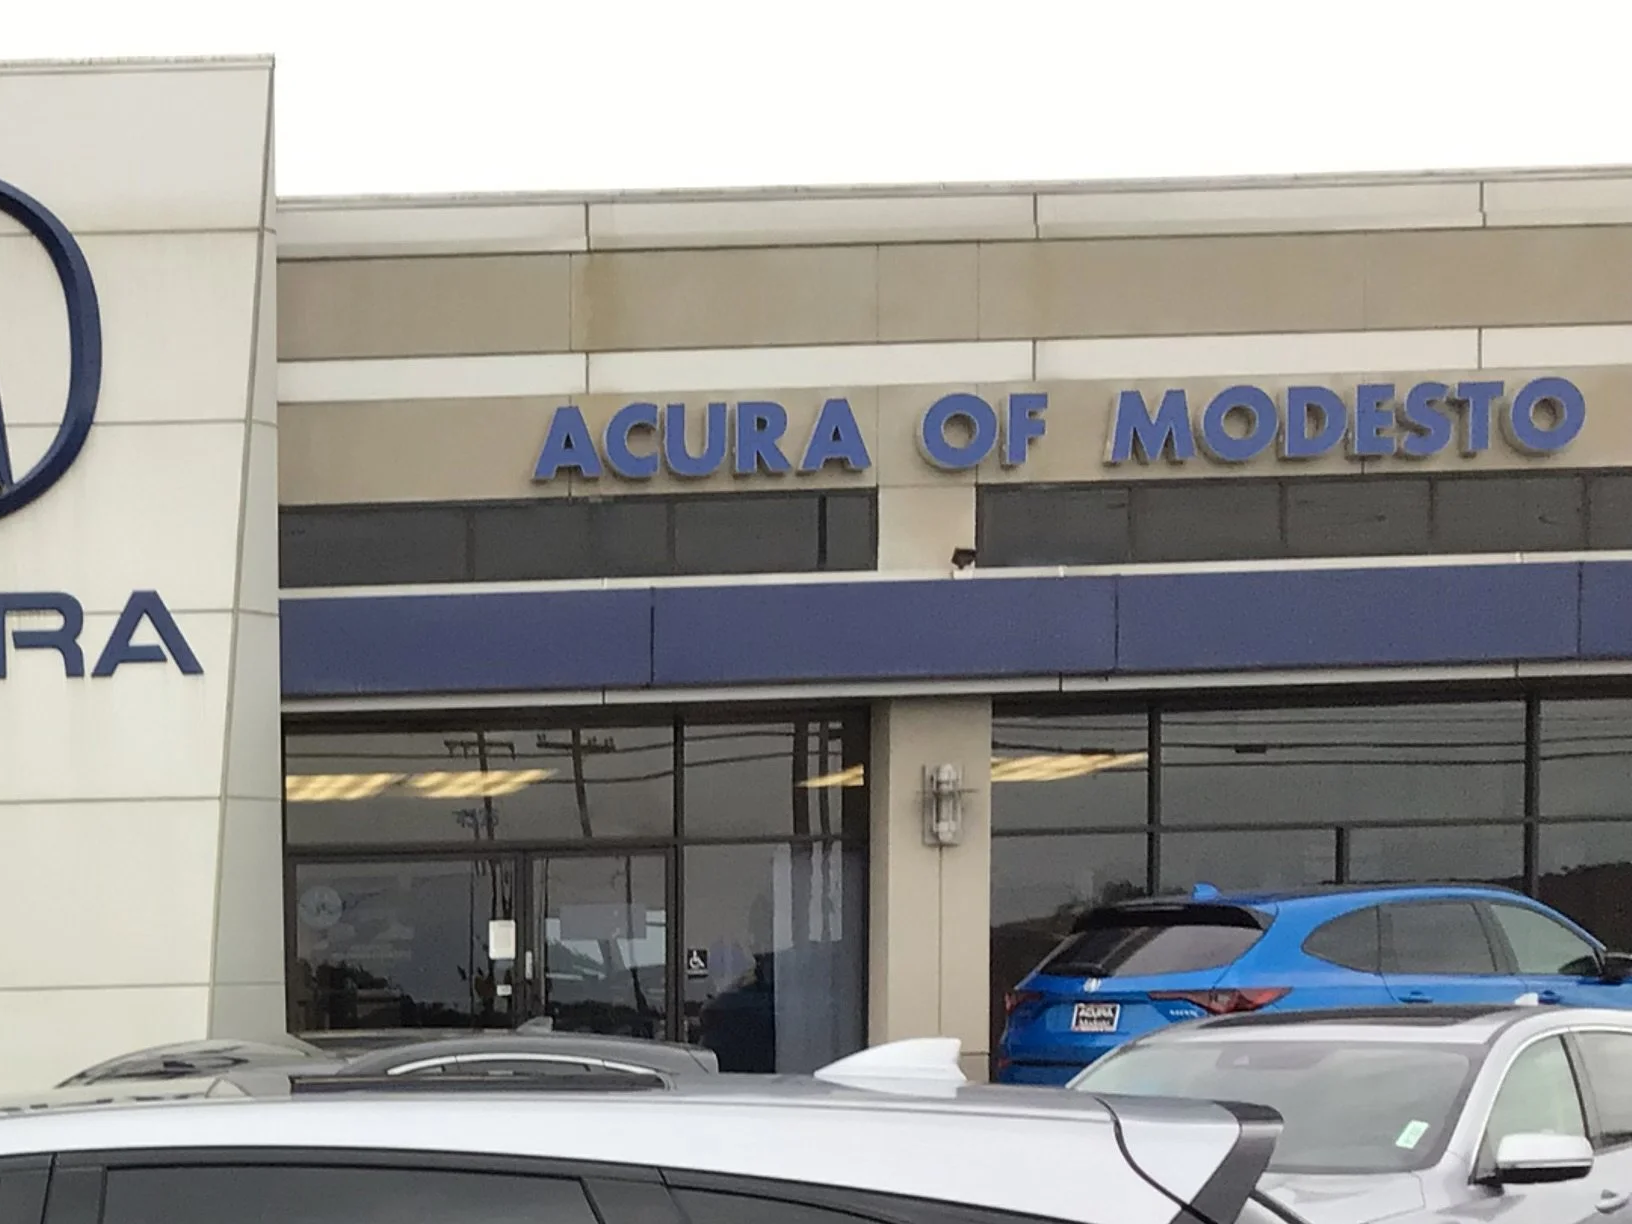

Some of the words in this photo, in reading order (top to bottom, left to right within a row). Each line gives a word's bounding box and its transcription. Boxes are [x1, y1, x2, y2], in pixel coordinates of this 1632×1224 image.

[531, 397, 872, 480] ACURA
[920, 392, 1049, 470] OF
[1107, 376, 1586, 464] MODESTO
